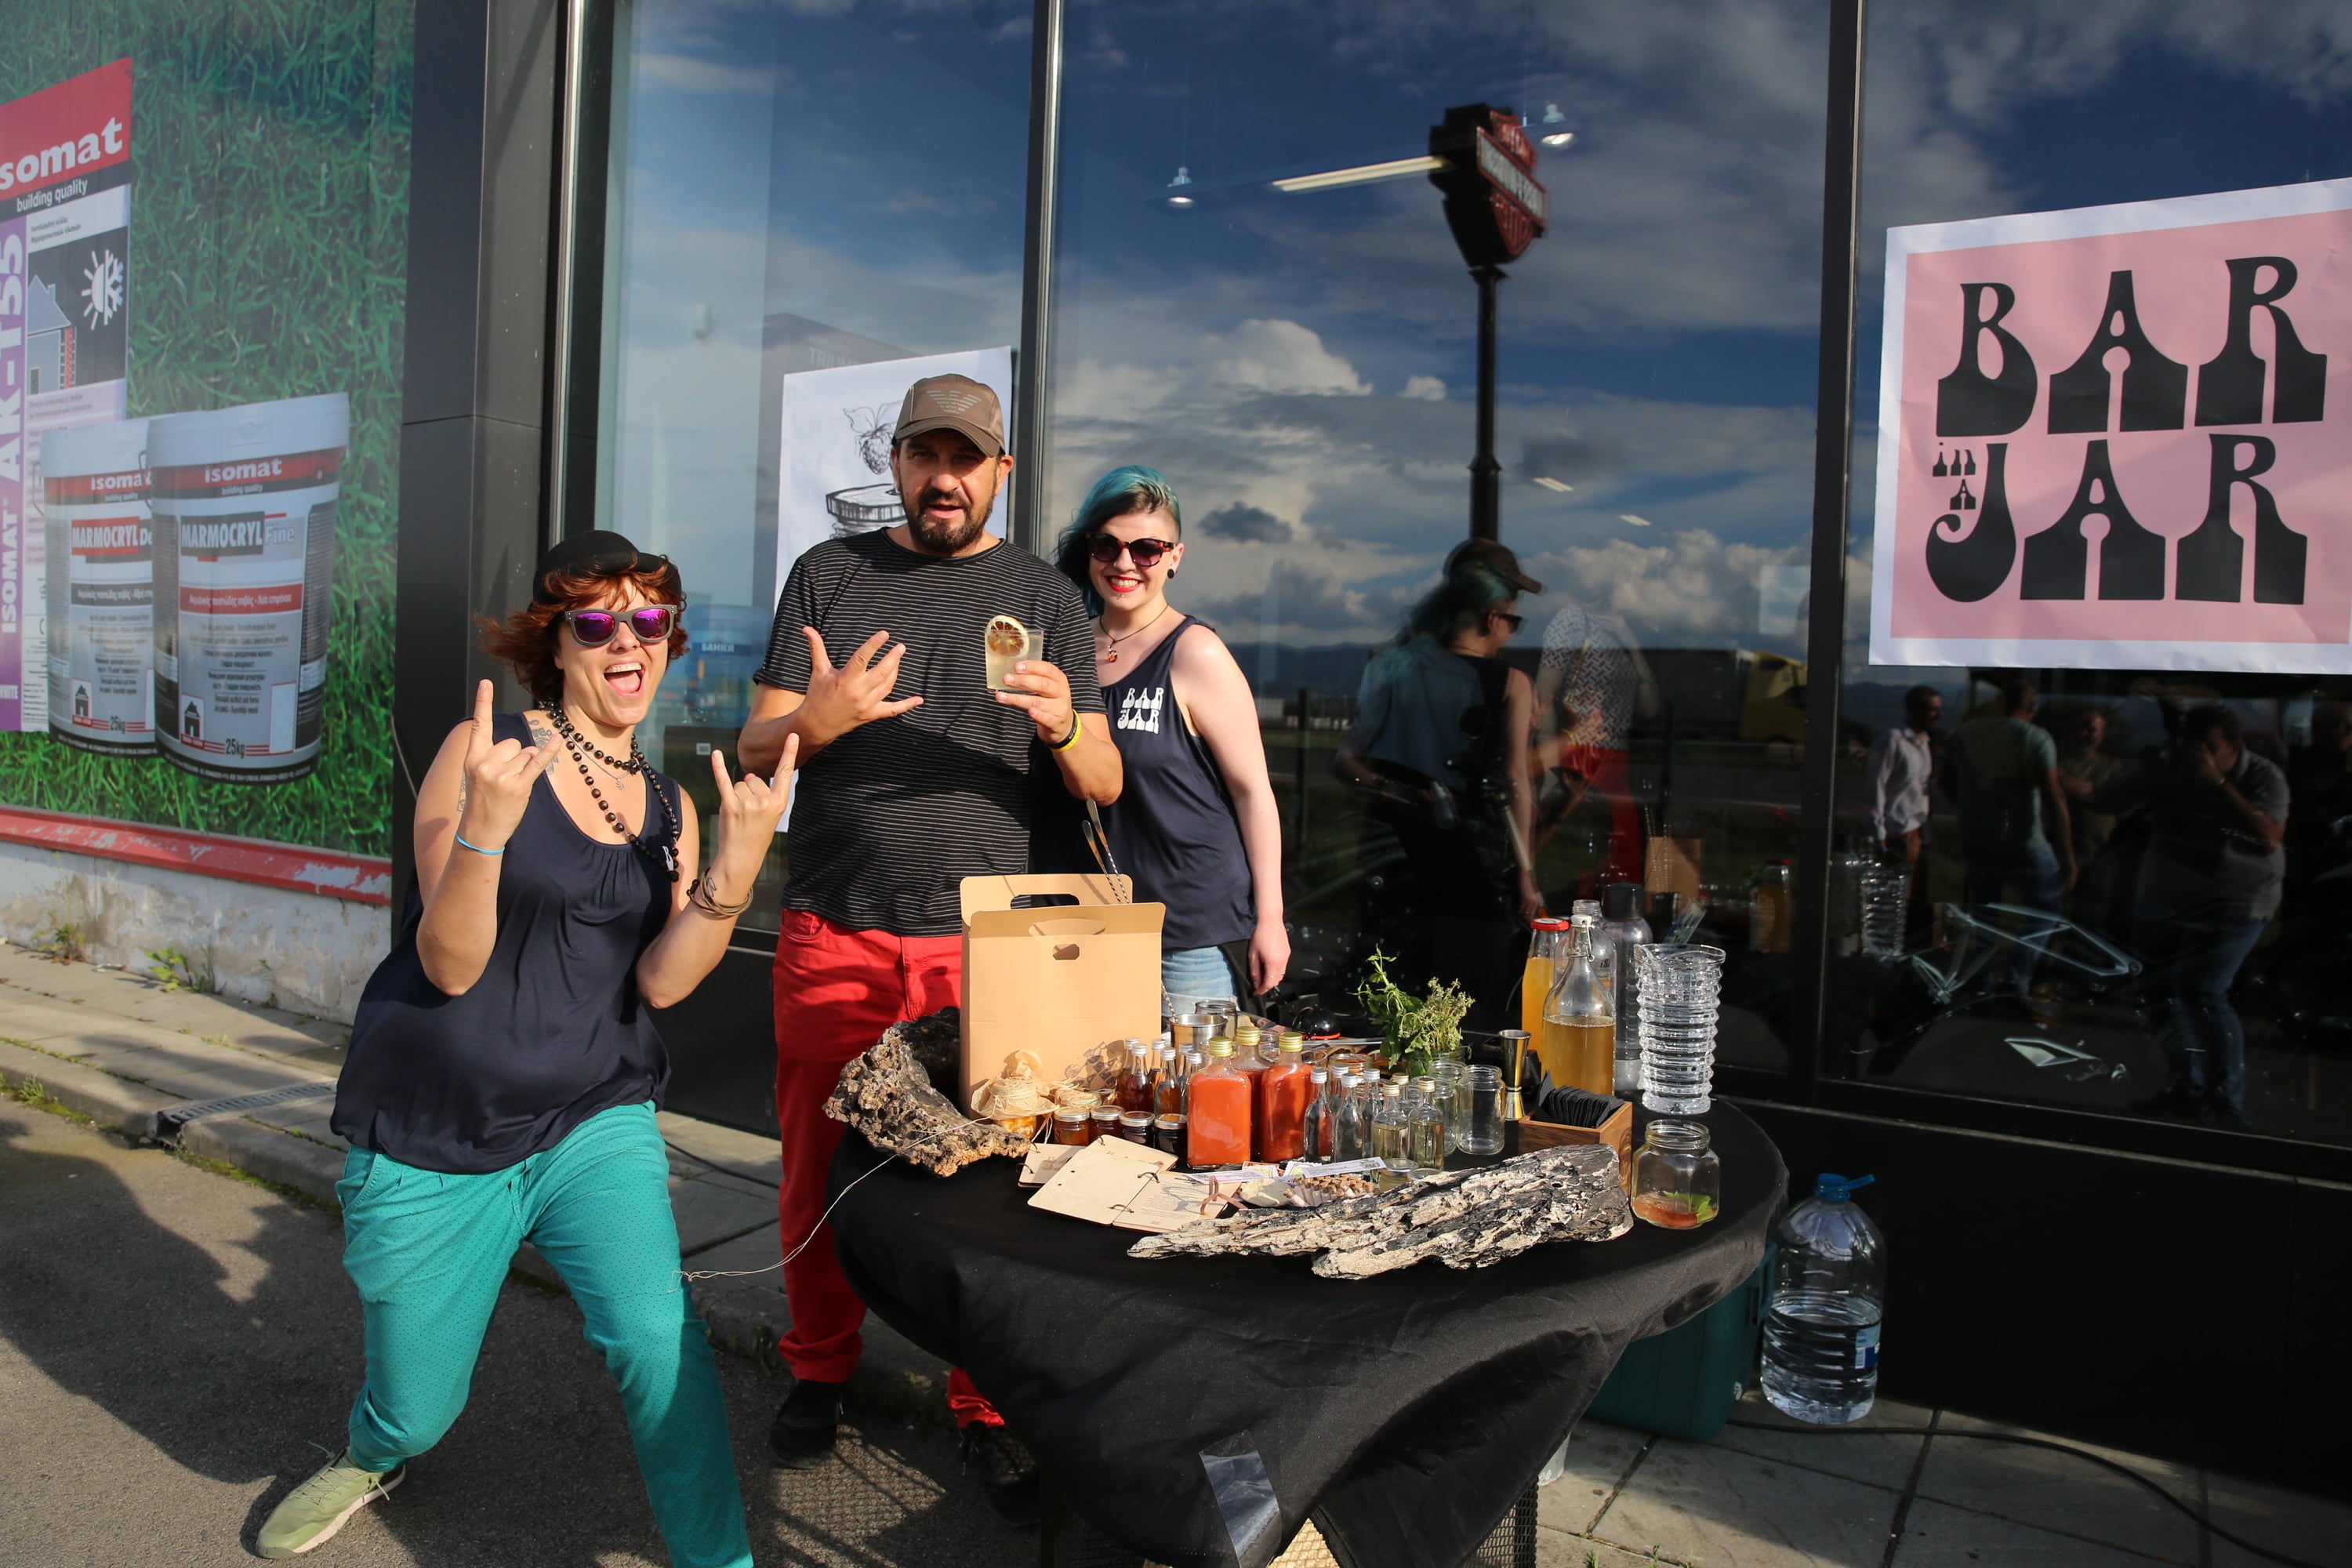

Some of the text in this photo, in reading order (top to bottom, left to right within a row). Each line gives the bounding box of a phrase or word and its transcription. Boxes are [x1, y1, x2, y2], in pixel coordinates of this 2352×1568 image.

[16, 179, 88, 212] building quality
[1936, 256, 2327, 437] BAR
[205, 458, 282, 483] isomat
[1933, 442, 1976, 477] in
[1950, 479, 1976, 510] A
[1926, 434, 2307, 605] JAR
[72, 524, 139, 548] MARMOCRYL
[181, 521, 294, 548] MARMOCRYL Fine
[2, 510, 18, 633] ISOMAT
[1122, 688, 1163, 710] BAR
[1117, 708, 1159, 734] JAR
[226, 739, 245, 758] 25kg
